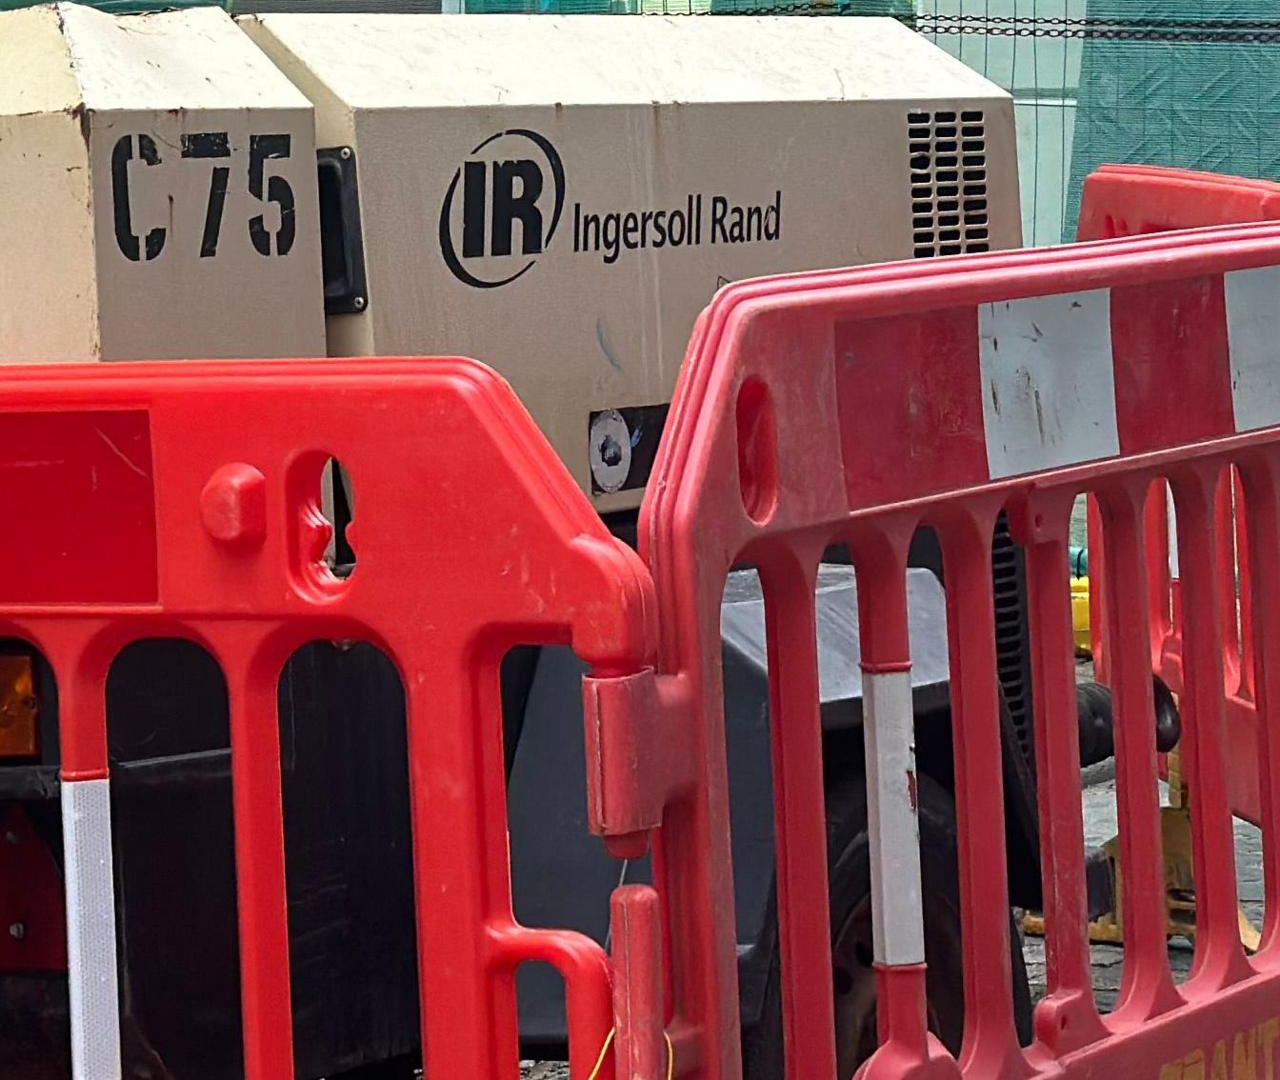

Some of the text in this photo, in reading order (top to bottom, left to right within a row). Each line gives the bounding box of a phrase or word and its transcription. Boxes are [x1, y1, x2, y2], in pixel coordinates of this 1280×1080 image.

[111, 132, 296, 262] C75
[463, 158, 543, 259] IR
[573, 190, 781, 264] Ingersoll Rand
